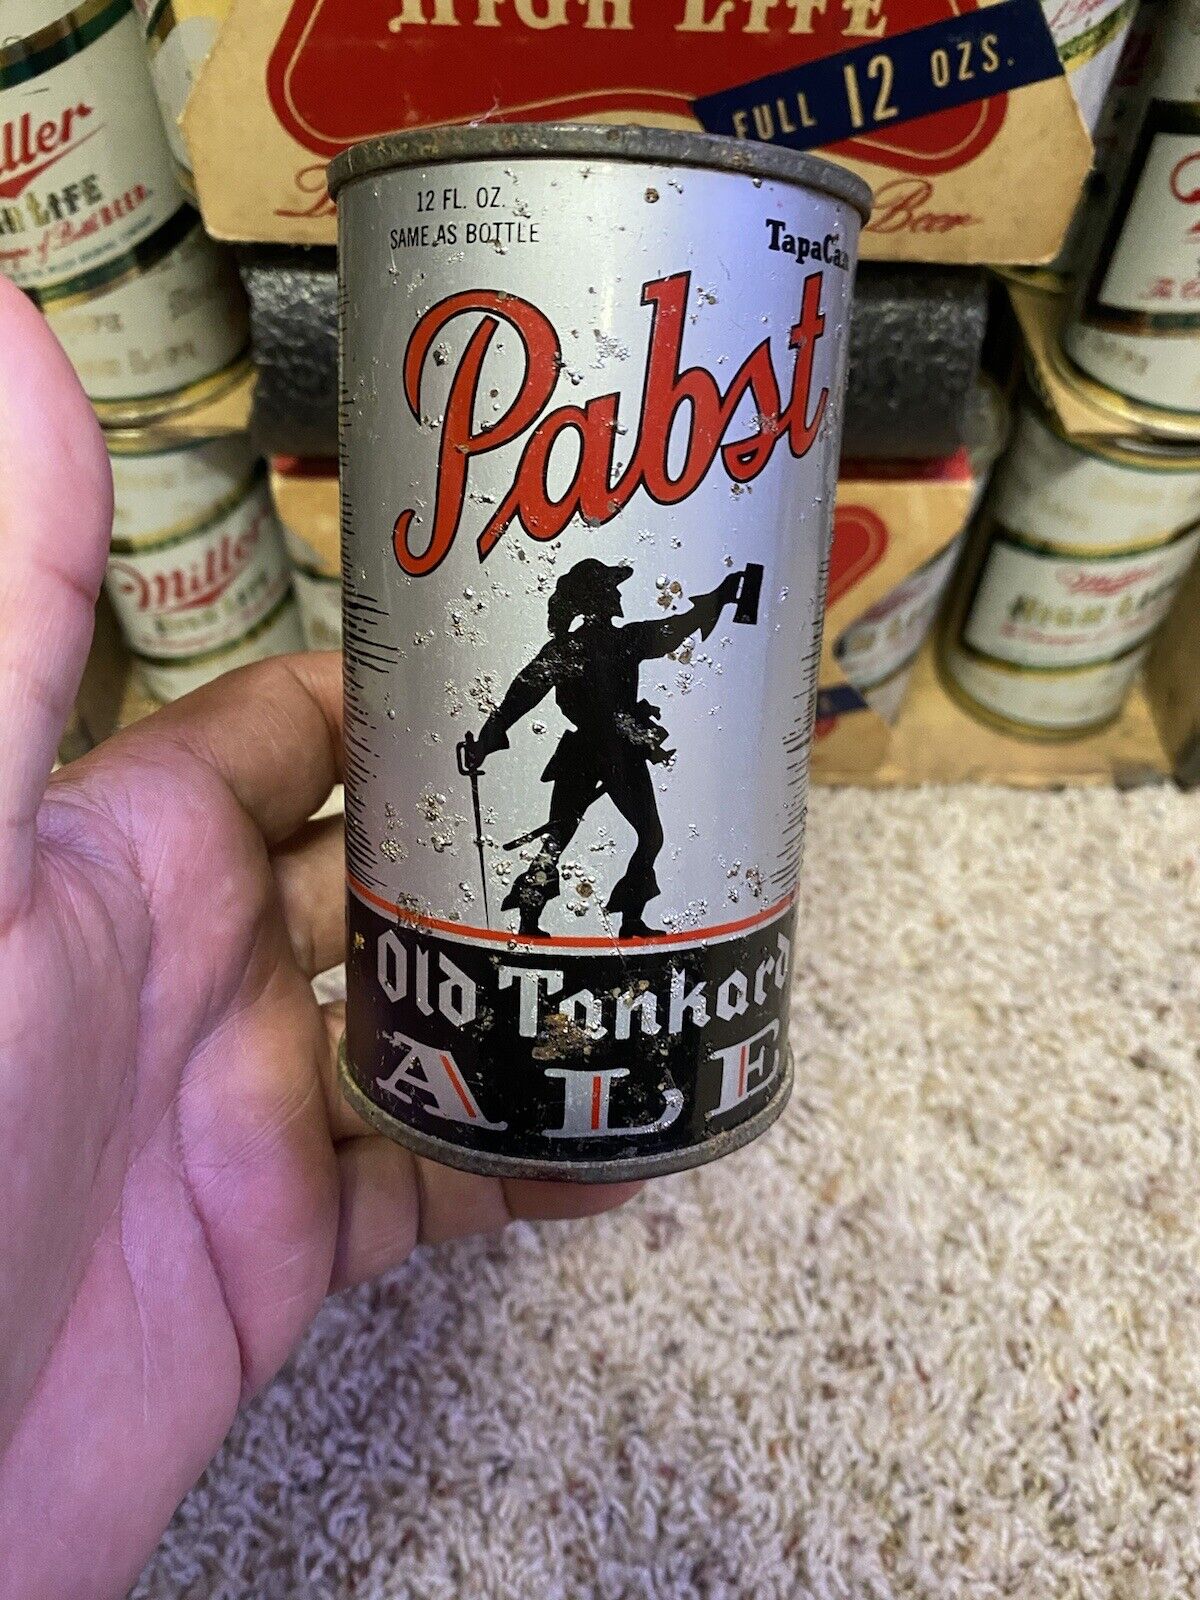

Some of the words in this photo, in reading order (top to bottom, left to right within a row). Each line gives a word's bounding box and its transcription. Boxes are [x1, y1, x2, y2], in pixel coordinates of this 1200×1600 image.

[732, 91, 817, 140] FULL
[843, 53, 899, 128] 12
[930, 34, 1015, 88] OZS.
[0, 103, 93, 173] ller
[390, 225, 429, 250] SAME
[437, 224, 457, 245] AS
[466, 222, 540, 244] BOTTLE
[417, 190, 435, 213] 12
[443, 188, 467, 210] FL.
[476, 186, 506, 209] OZ.
[392, 270, 829, 577] Pabst
[376, 929, 477, 1028] Old
[375, 1017, 781, 1140] ALE
